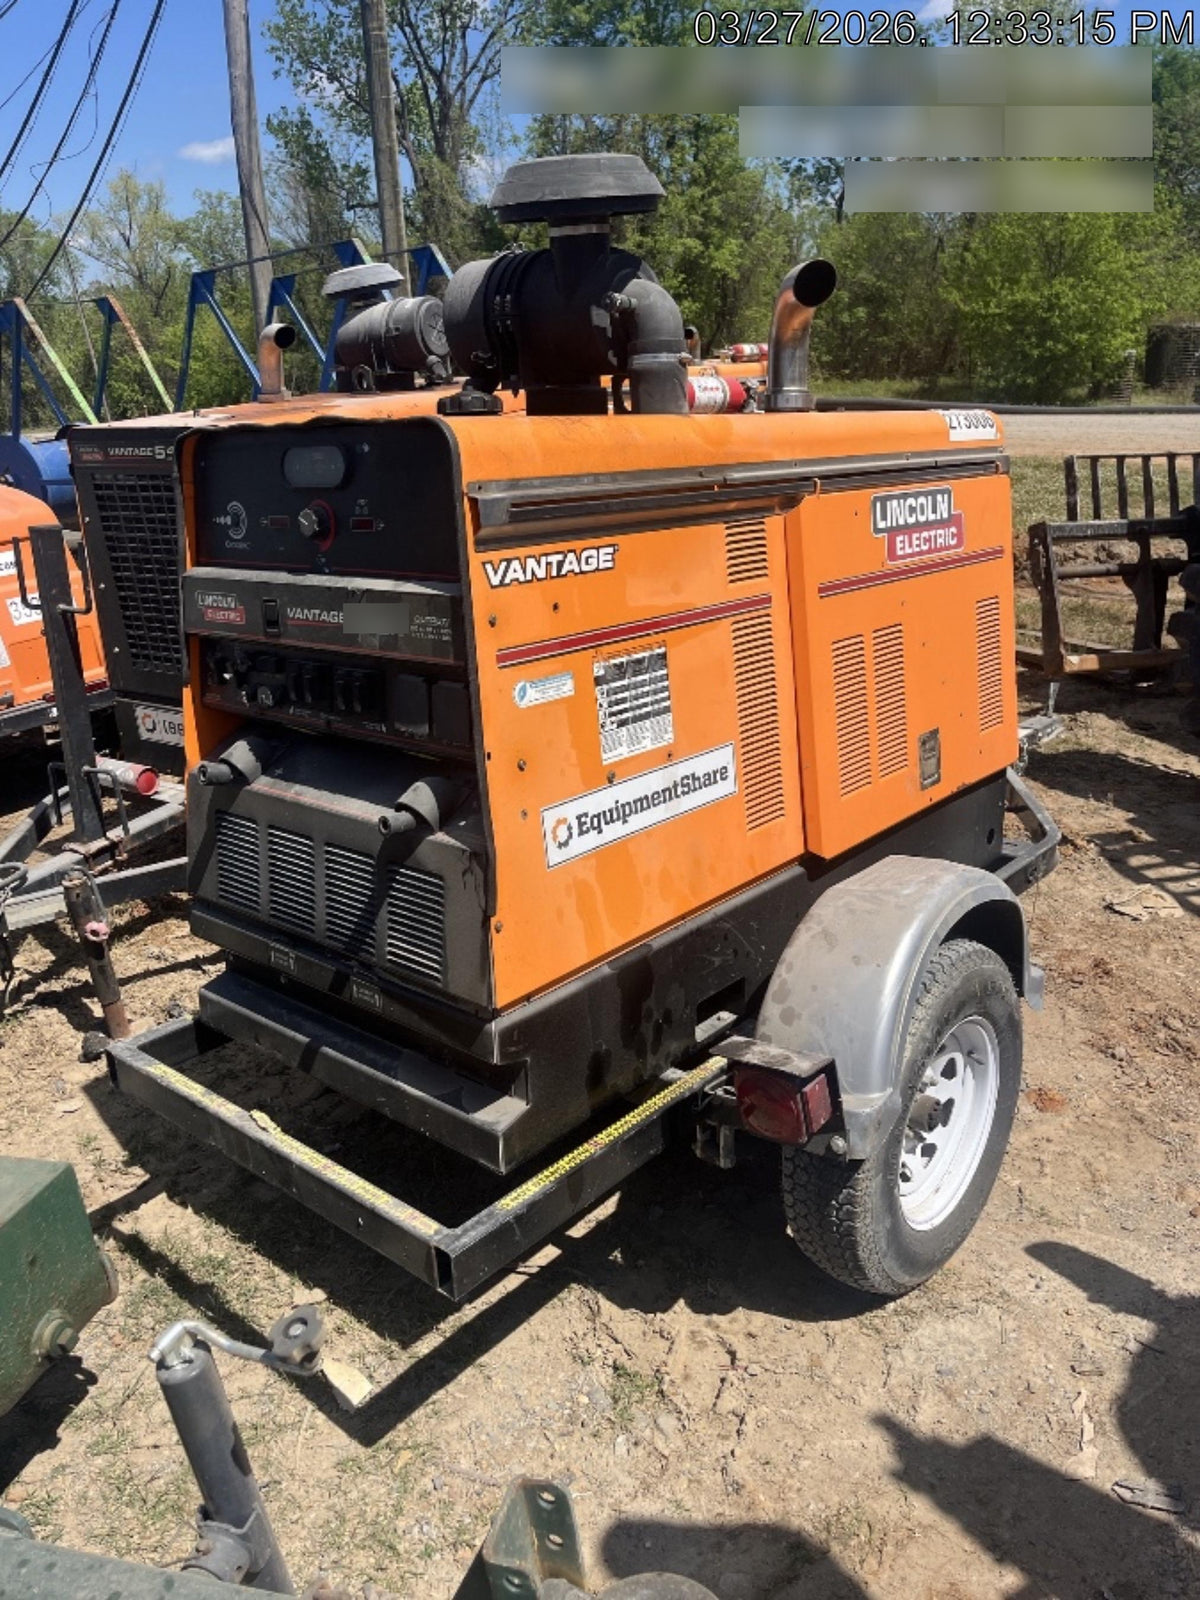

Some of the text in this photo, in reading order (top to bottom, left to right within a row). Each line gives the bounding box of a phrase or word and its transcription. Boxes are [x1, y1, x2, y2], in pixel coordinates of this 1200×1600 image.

[876, 493, 949, 529] LINCOLN
[895, 526, 958, 556] ELECTRIC
[482, 544, 617, 588] VANTAGE
[287, 607, 344, 624] VANTAGE
[575, 763, 730, 838] EquipmentShare
